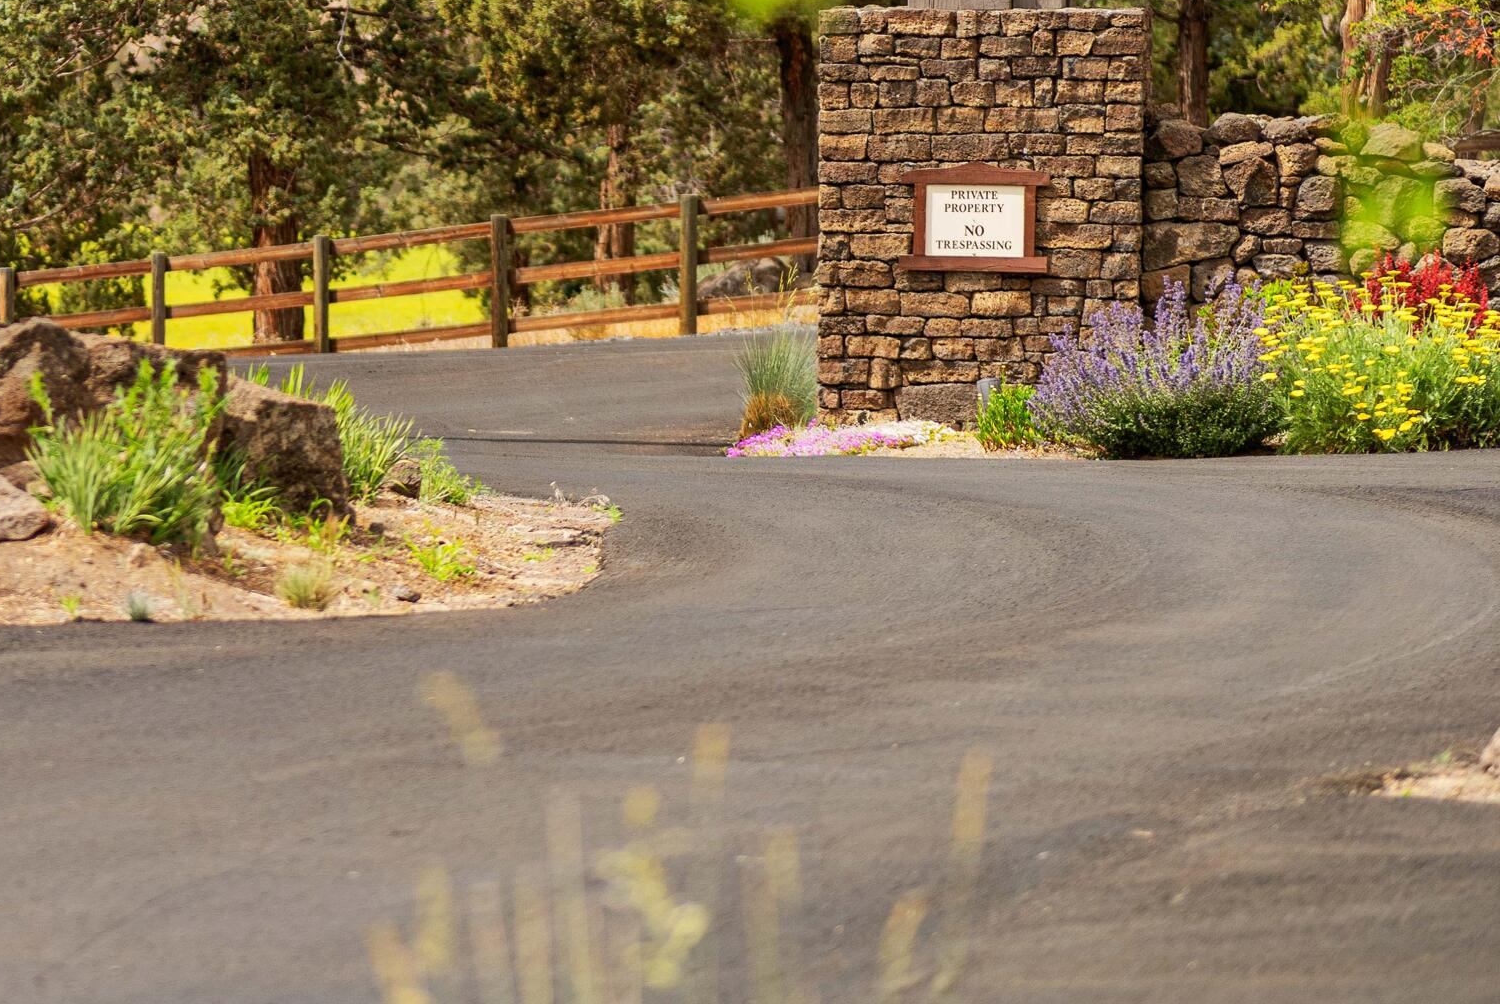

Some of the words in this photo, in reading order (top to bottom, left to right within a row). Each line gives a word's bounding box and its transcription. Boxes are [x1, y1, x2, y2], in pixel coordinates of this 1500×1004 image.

[951, 190, 998, 200] PRIVATE
[944, 203, 1004, 213] PROPERTY
[964, 224, 985, 237] NO
[936, 240, 1012, 250] TRESPASSING
